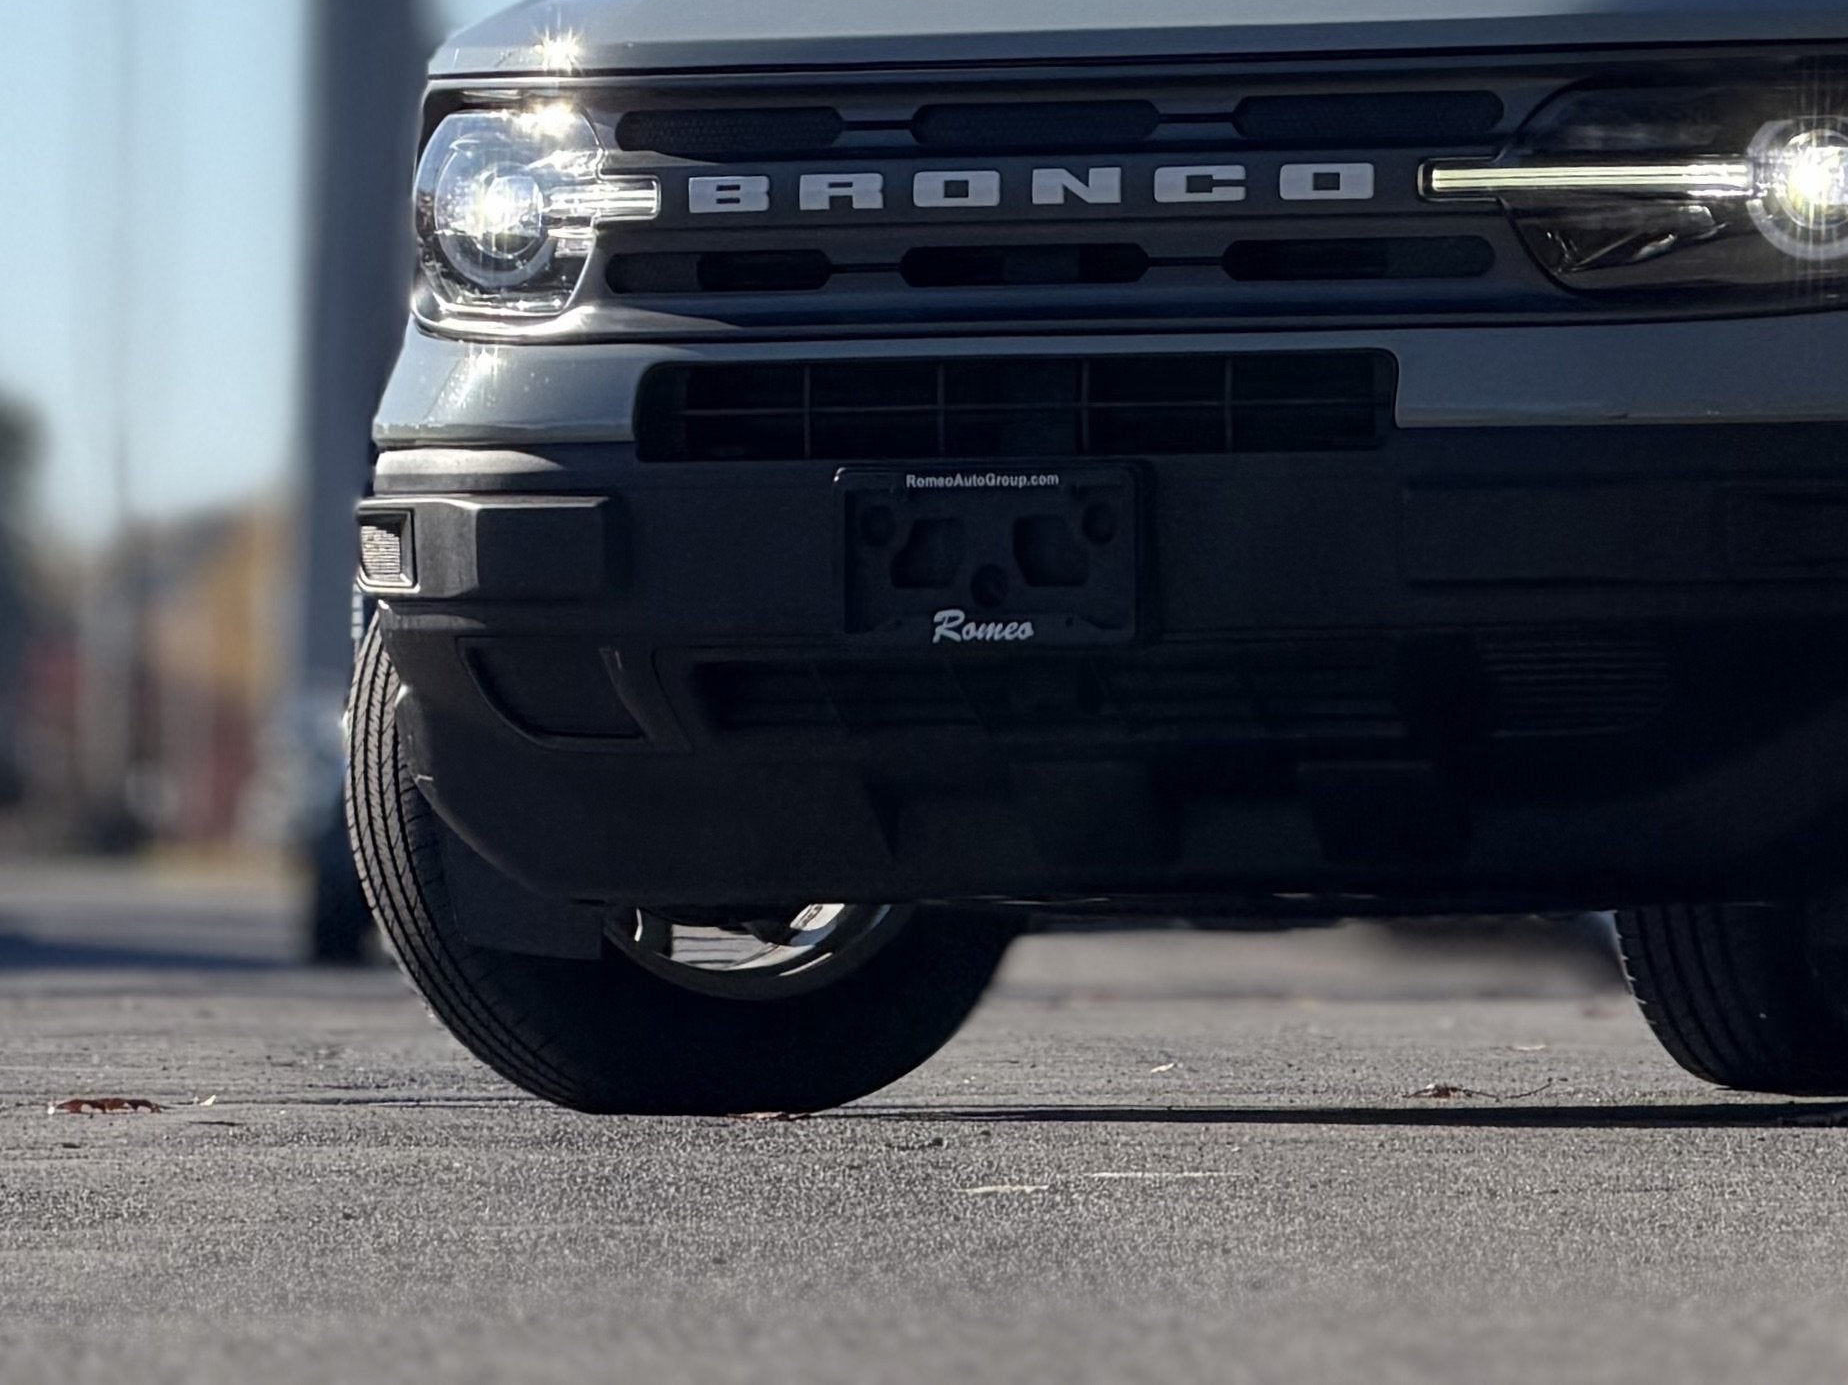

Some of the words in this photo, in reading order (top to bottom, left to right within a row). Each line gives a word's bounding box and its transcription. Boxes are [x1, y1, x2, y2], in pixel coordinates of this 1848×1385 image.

[688, 162, 1375, 213] BRONCO
[905, 473, 1060, 488] RomeoAutoGroup.com
[931, 609, 1034, 643] Romeo
